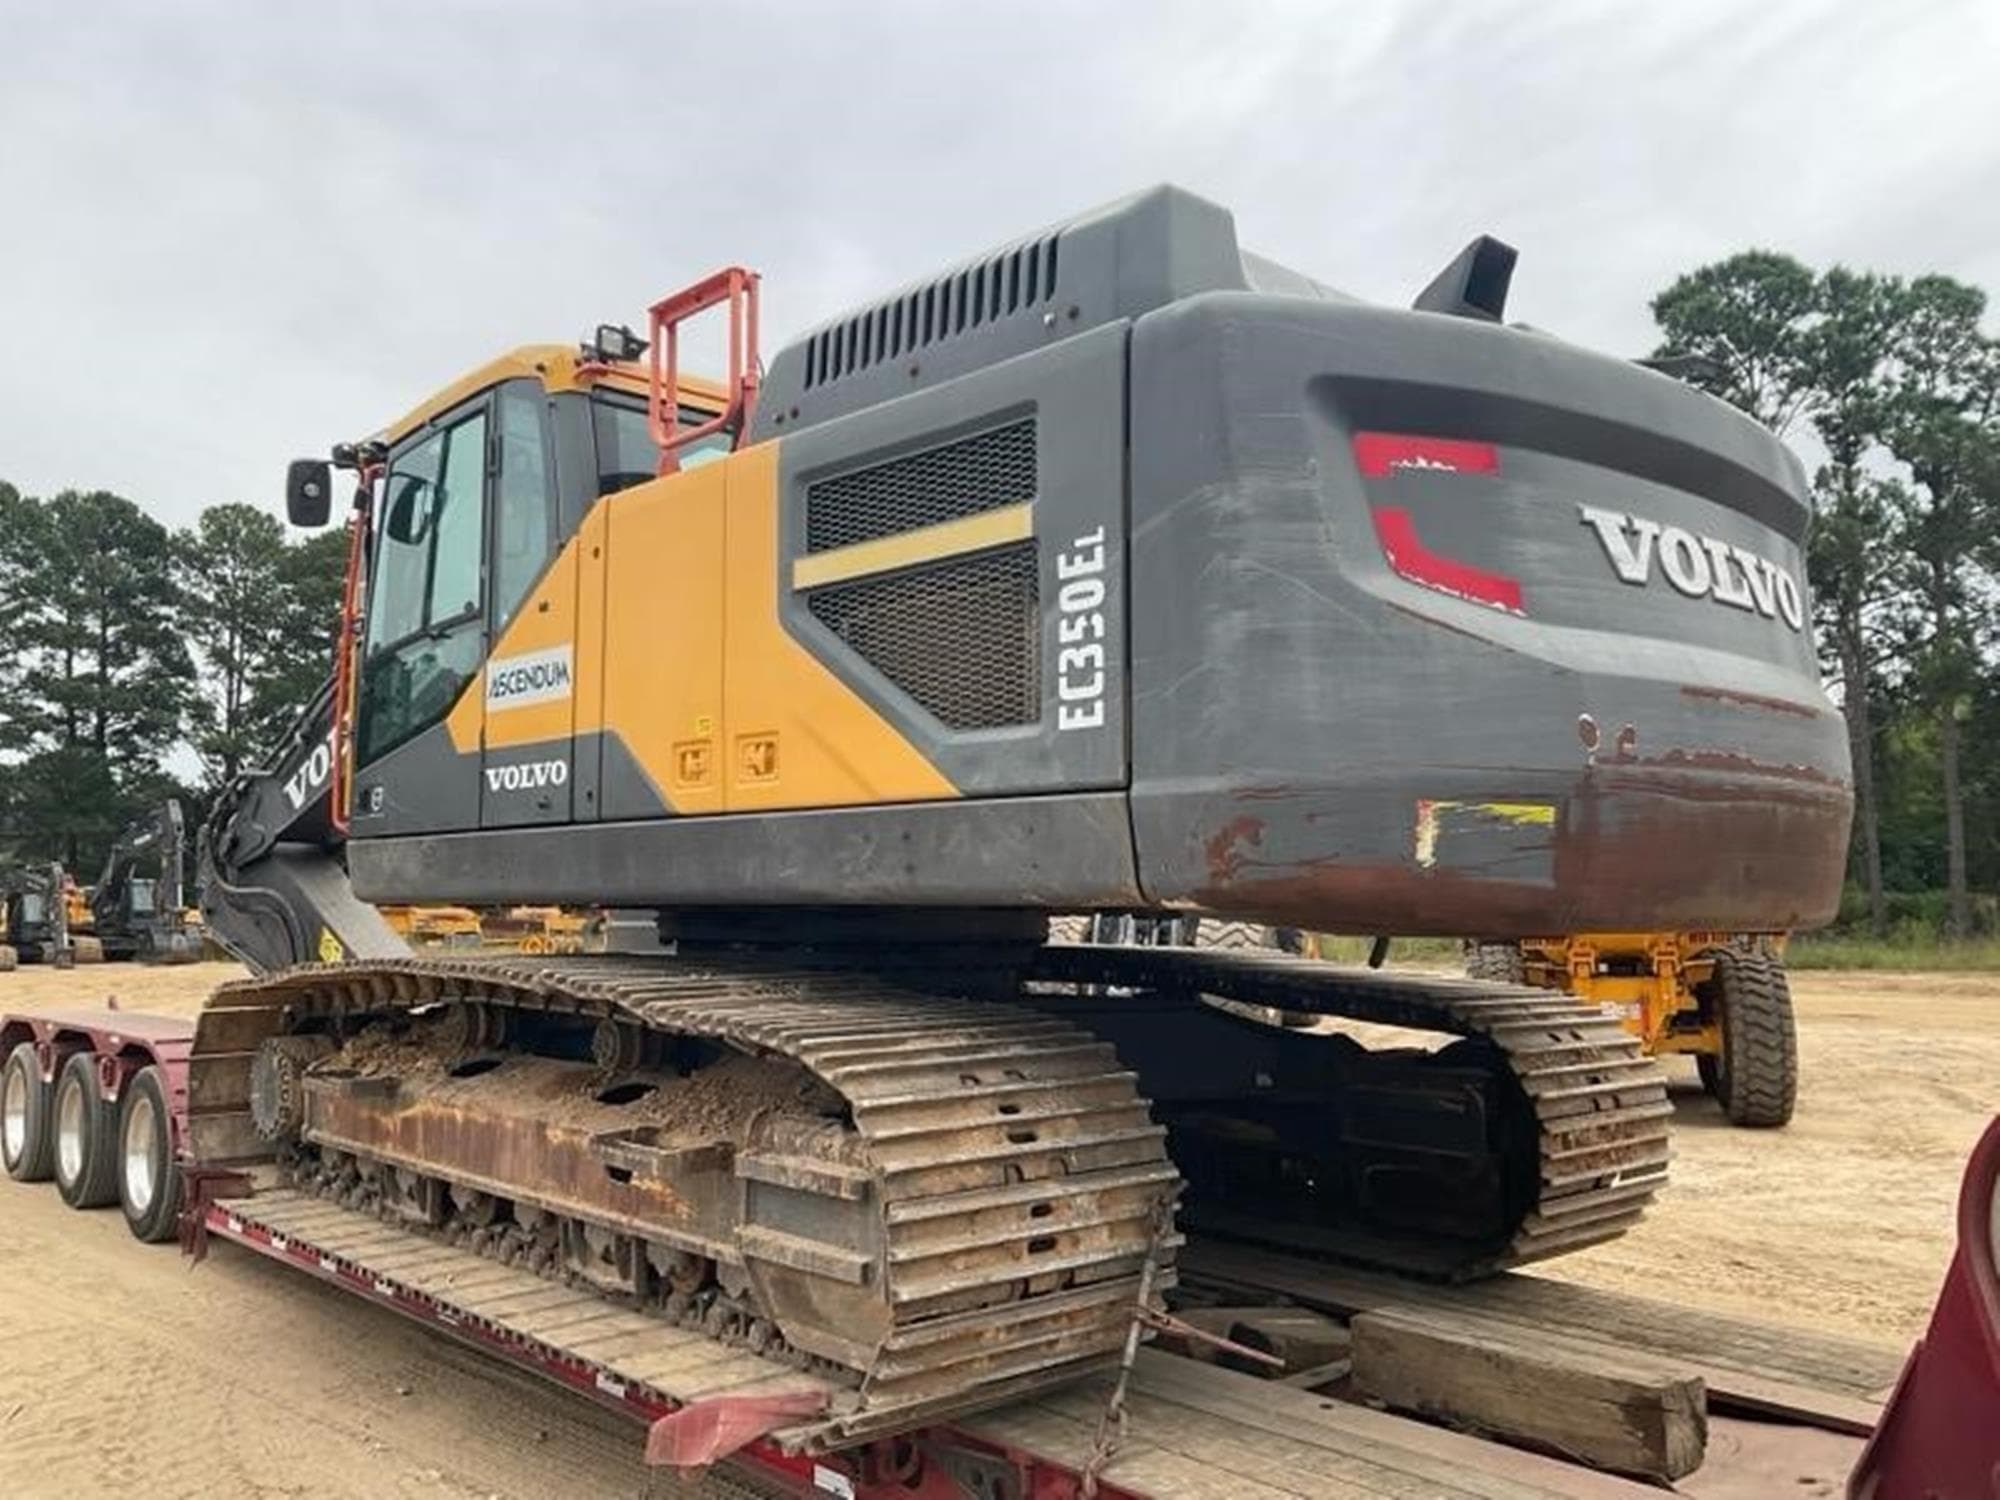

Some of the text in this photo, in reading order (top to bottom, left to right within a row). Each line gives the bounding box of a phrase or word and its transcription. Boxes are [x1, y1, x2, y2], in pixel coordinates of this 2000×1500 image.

[1578, 503, 1803, 633] VOLVO
[490, 661, 570, 698] ASCENDUM
[486, 759, 567, 792] VOLVO
